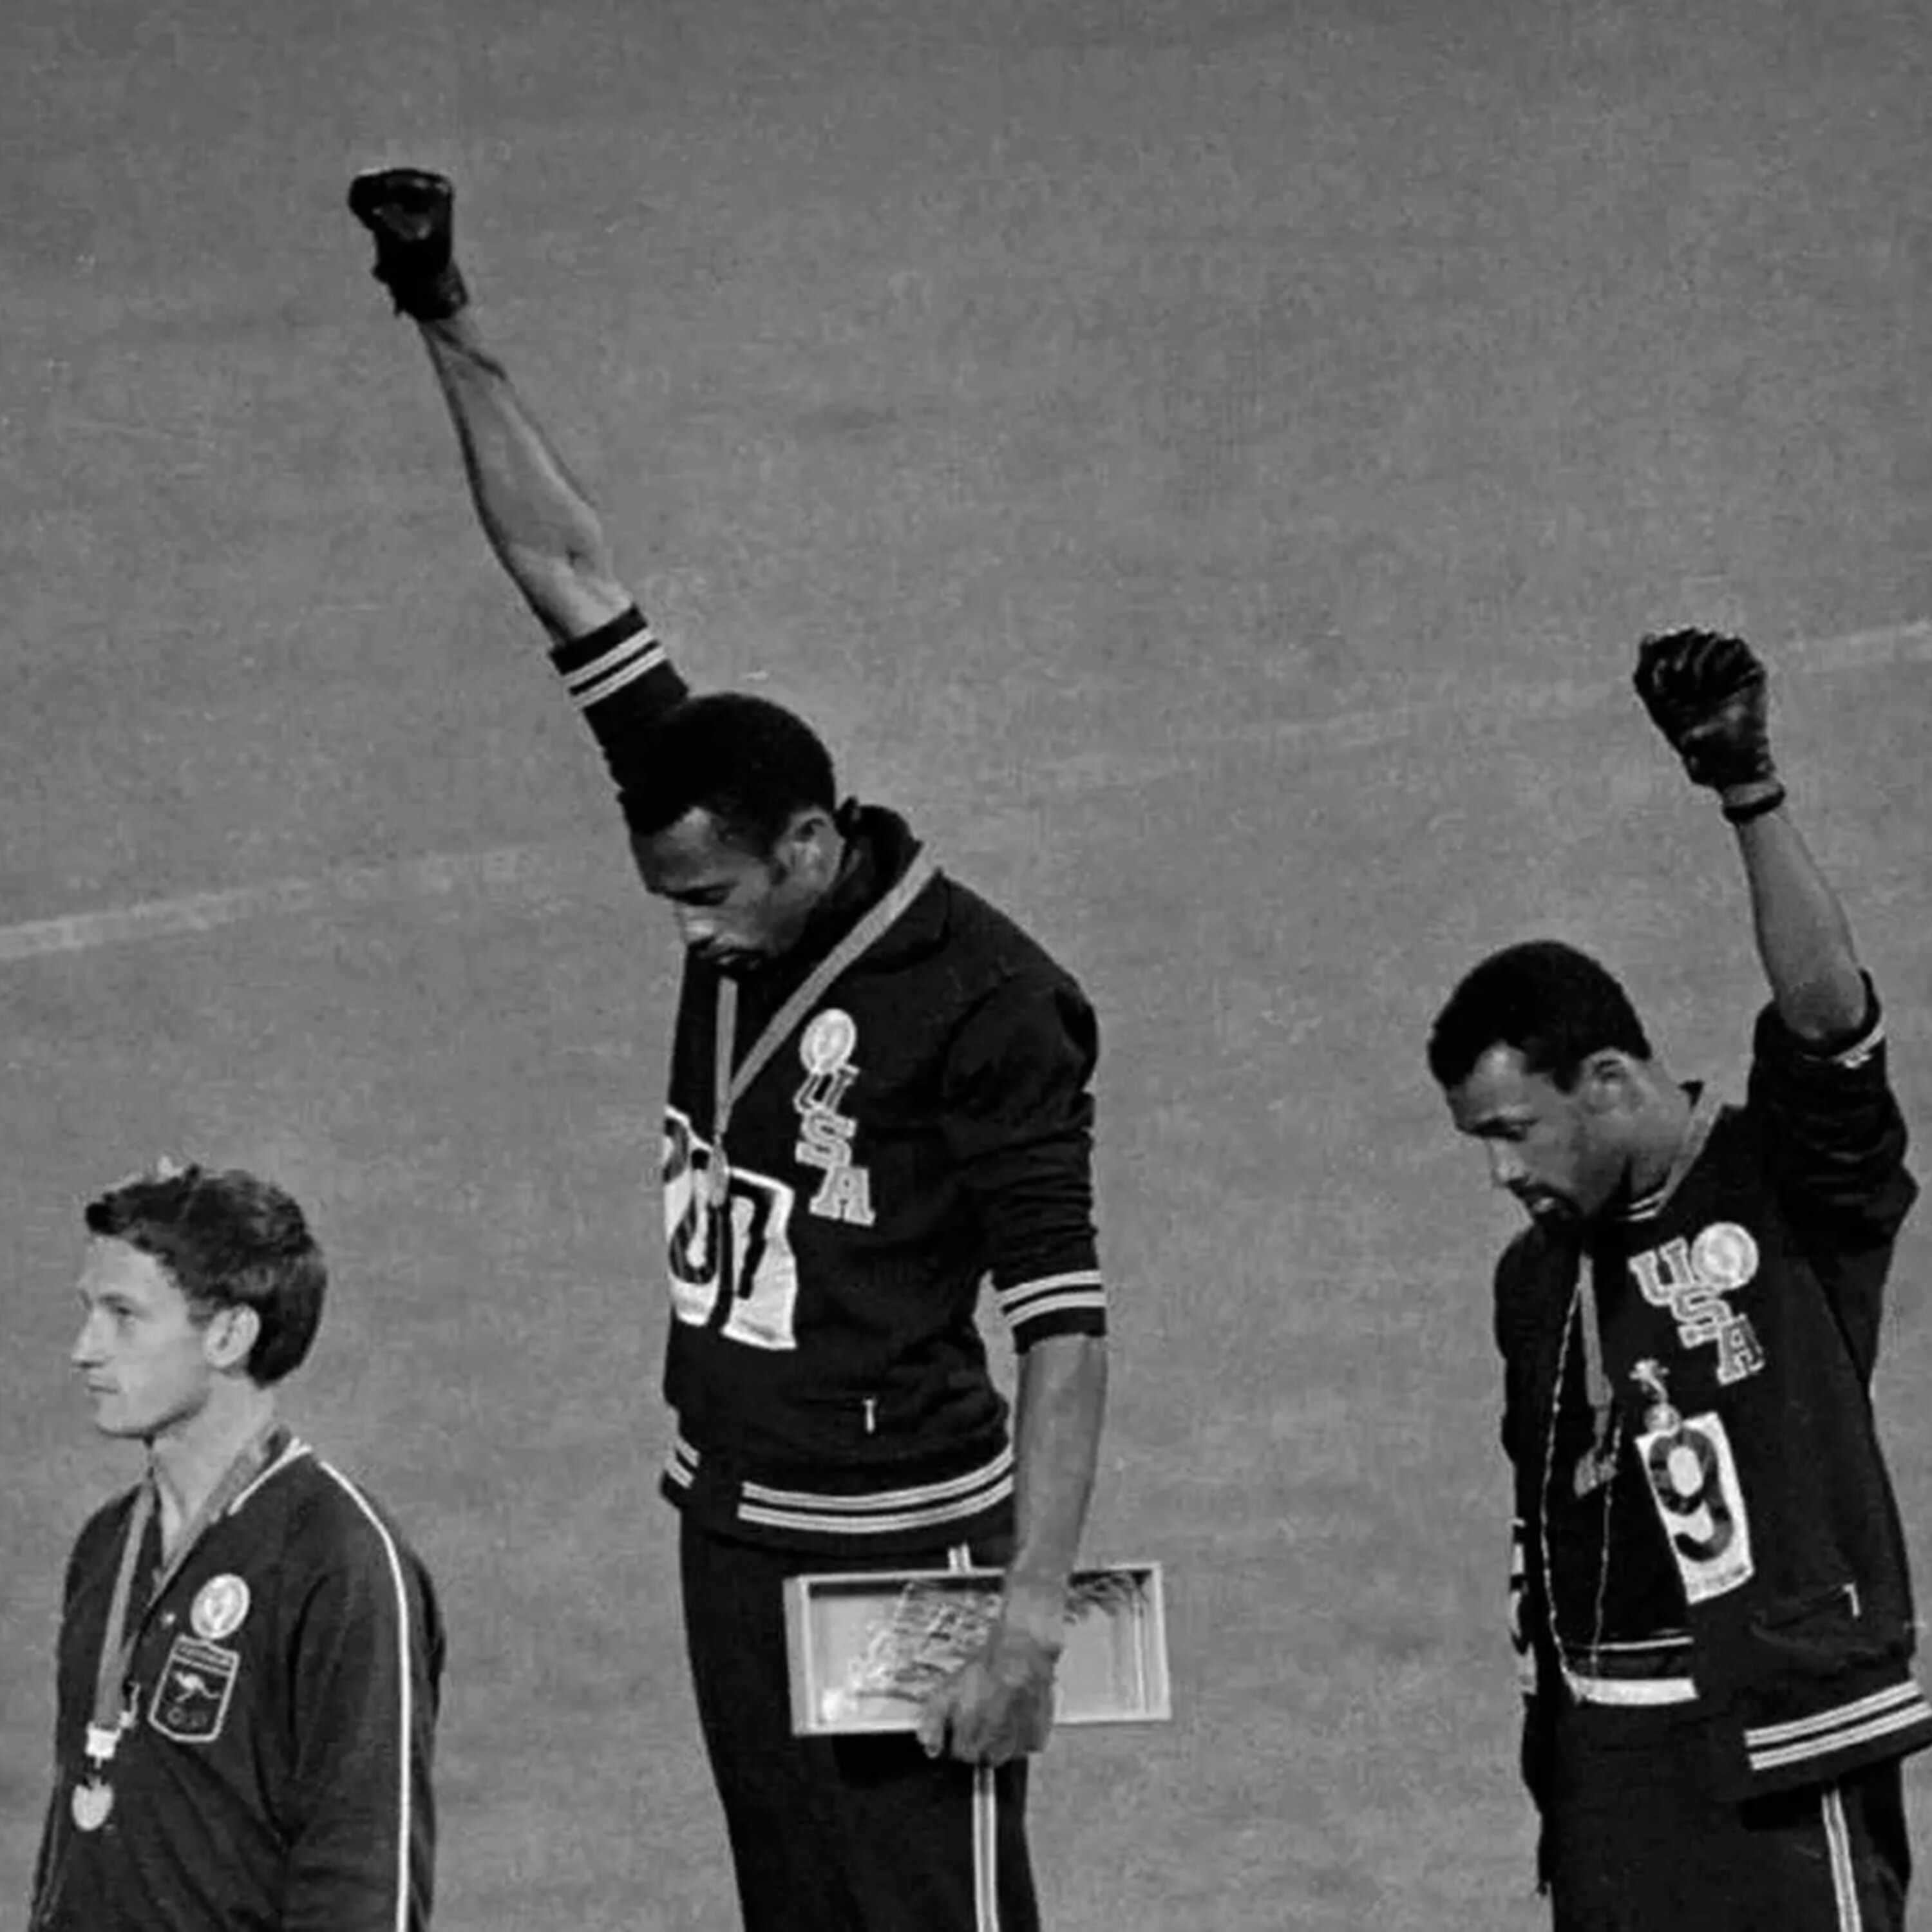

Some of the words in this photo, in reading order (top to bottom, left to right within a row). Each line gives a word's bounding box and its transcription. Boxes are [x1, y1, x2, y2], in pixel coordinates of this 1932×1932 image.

[793, 1066, 876, 1226] USA
[1628, 1235, 1765, 1385] USA
[1648, 1426, 1734, 1563] 9
